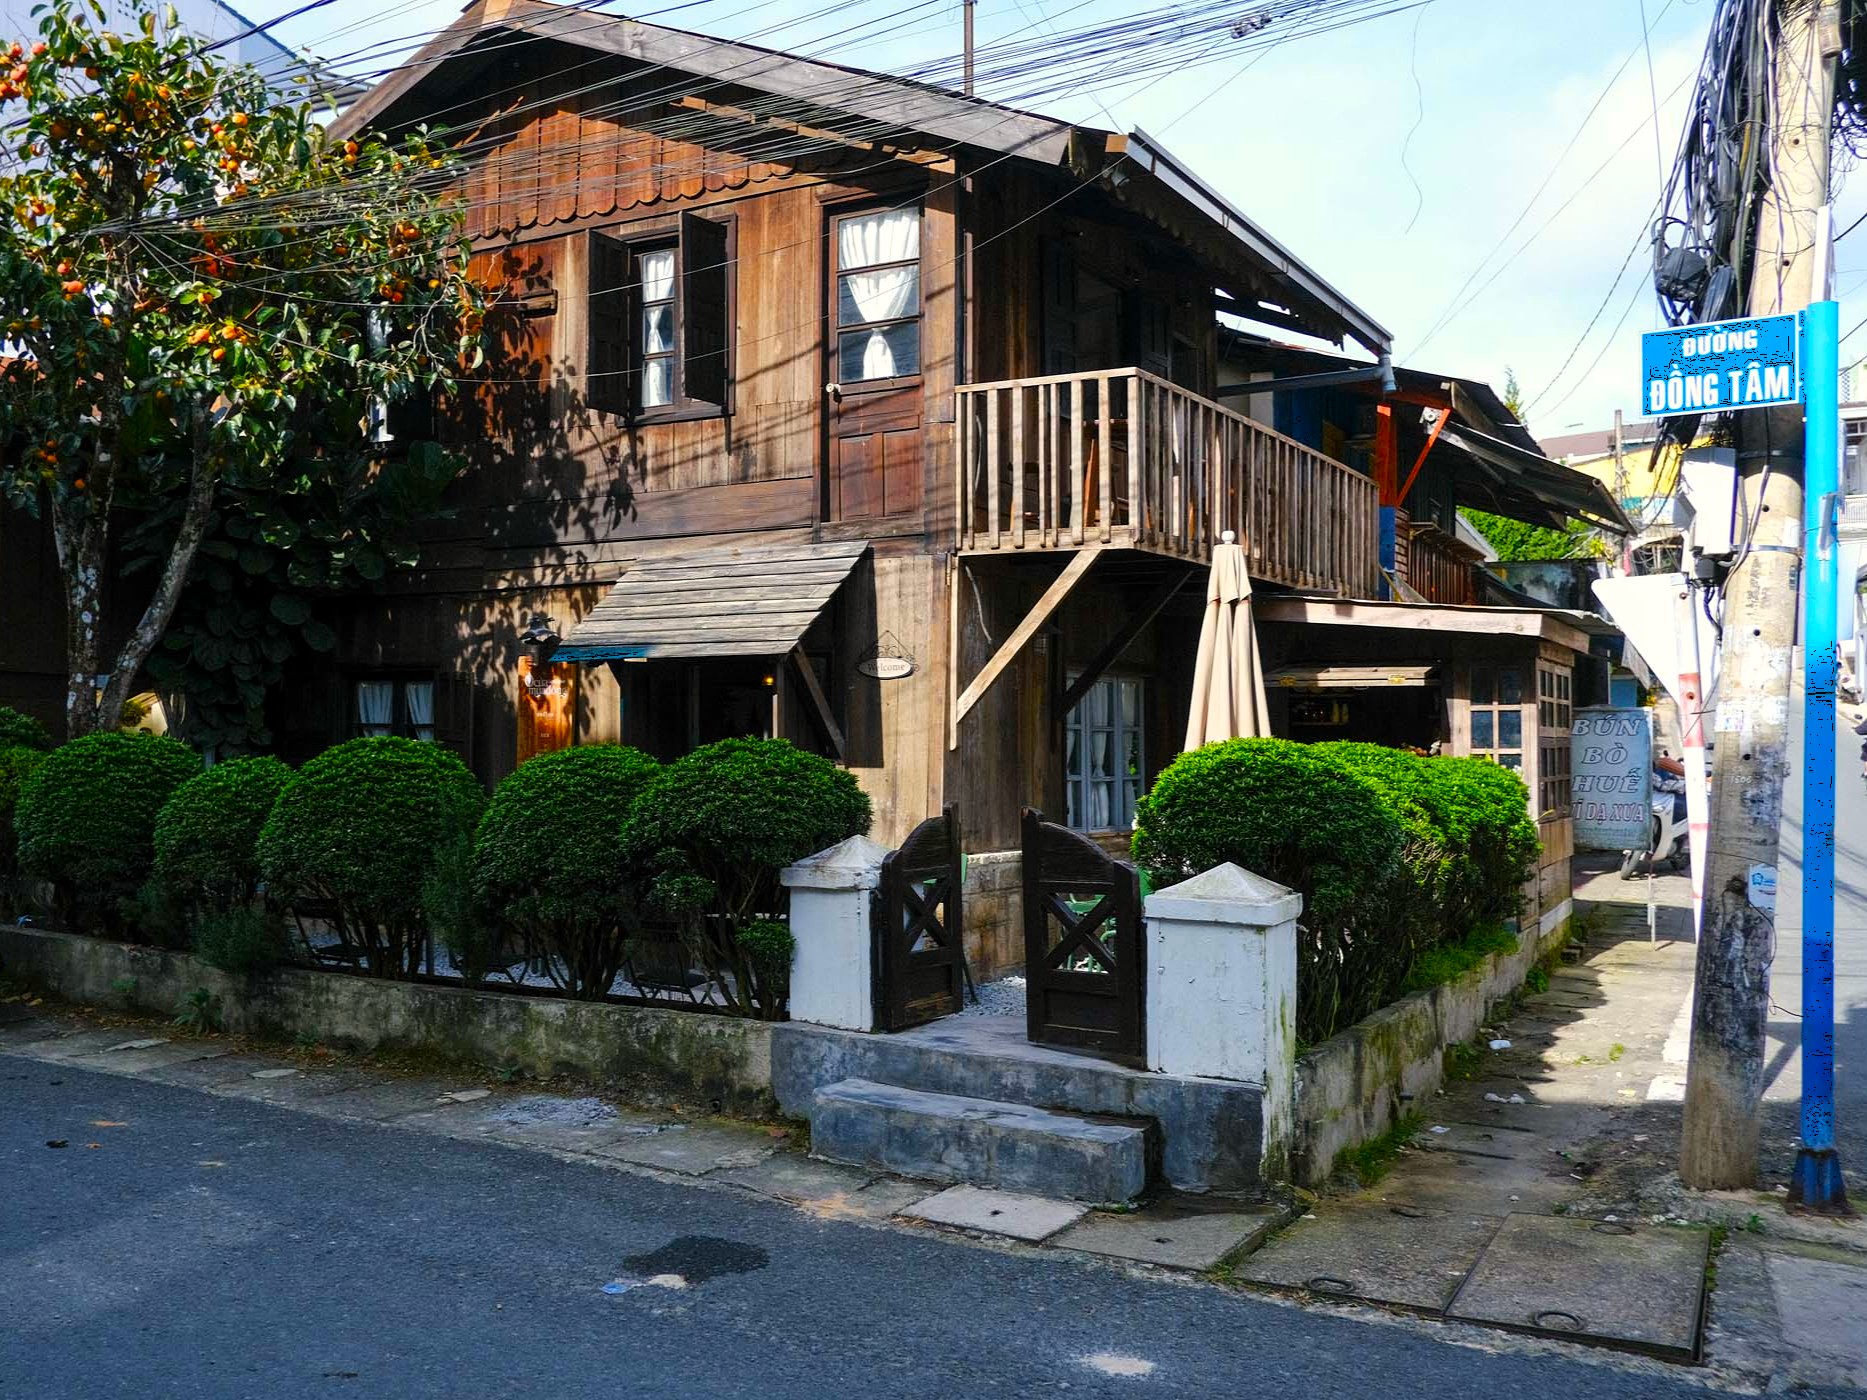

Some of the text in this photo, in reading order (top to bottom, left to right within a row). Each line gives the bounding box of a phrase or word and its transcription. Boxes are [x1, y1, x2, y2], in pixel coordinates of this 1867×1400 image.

[1682, 326, 1758, 357] ĐƯỜNG
[1649, 362, 1789, 411] ĐỒNG TÂM
[1572, 714, 1641, 736] BÚN
[1581, 743, 1628, 764] BÒ
[1572, 768, 1642, 793] HUẾ
[1586, 802, 1608, 825] DẠ
[1610, 803, 1644, 822] XƯA
